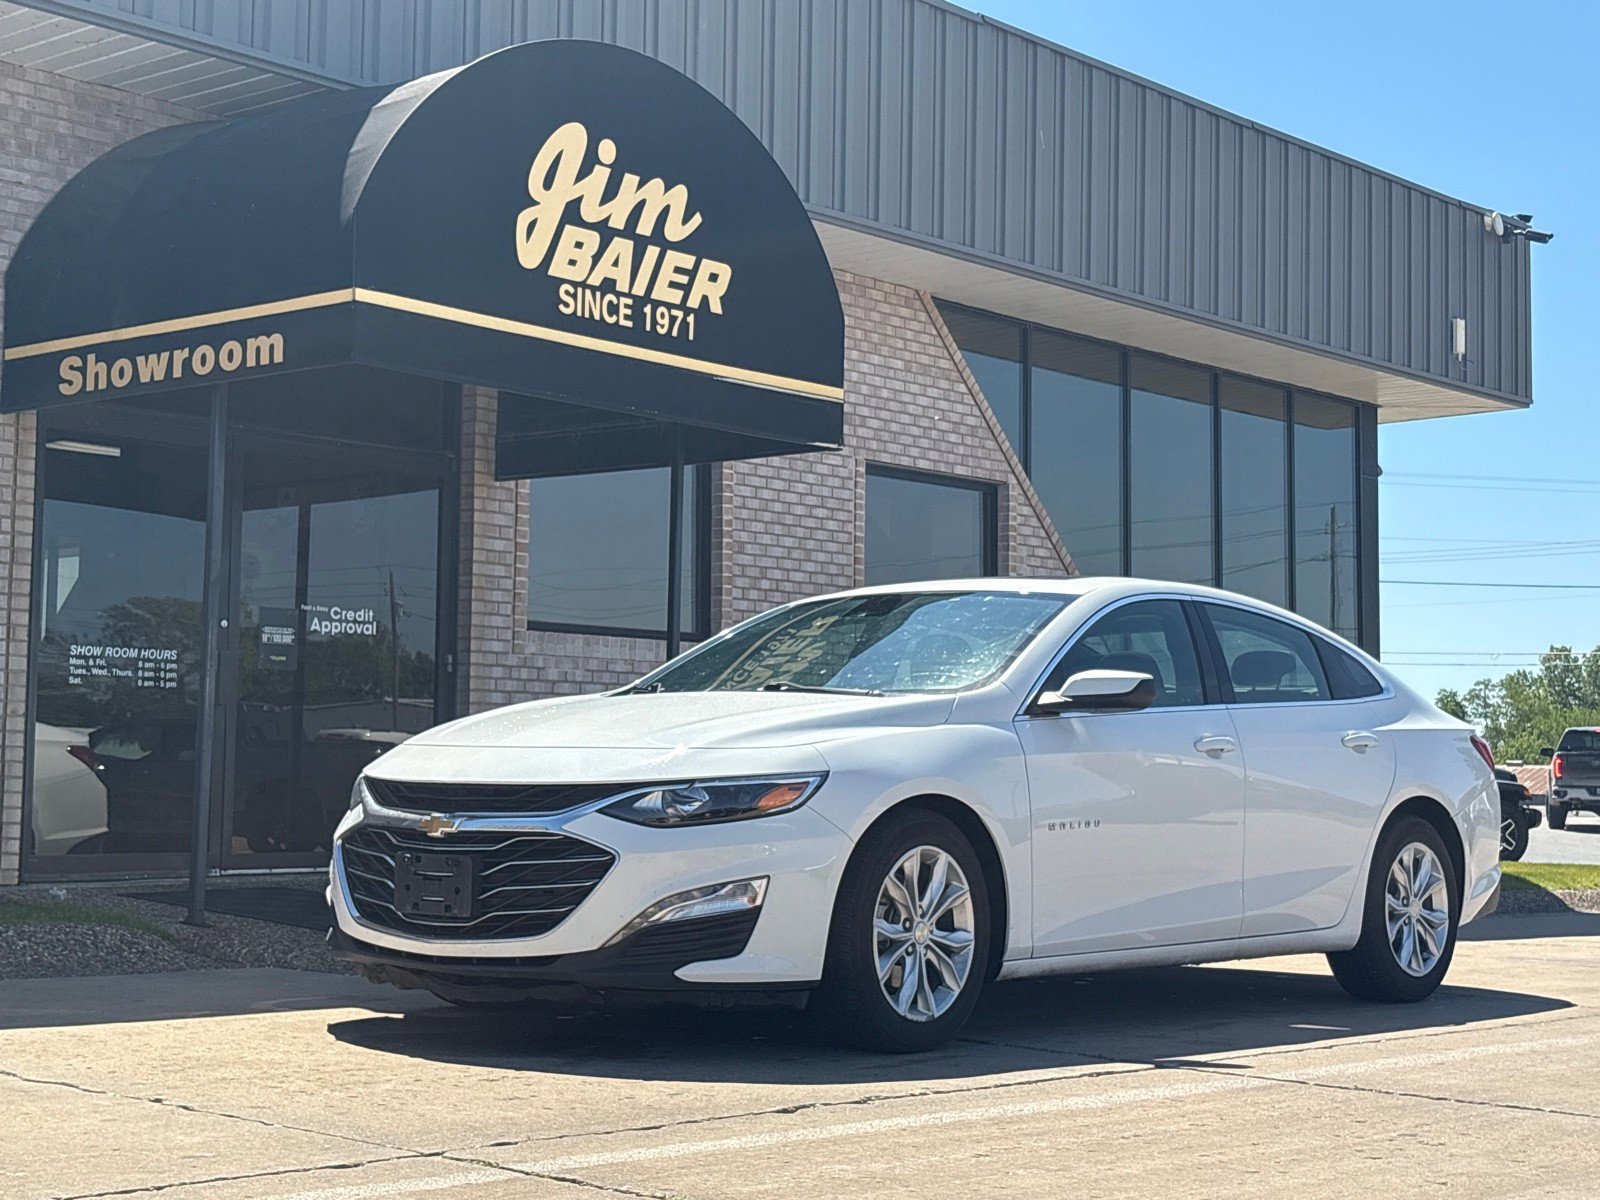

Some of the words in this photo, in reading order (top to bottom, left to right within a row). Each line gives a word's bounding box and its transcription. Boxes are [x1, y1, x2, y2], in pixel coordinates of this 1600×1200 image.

[515, 121, 703, 270] Jim
[547, 224, 733, 315] BAIER
[558, 283, 634, 328] SINCE
[643, 303, 695, 341] 1971
[58, 332, 285, 396] Showroom
[330, 606, 374, 622] Credit
[310, 617, 377, 636] Approval
[70, 645, 103, 656] SHOW
[105, 646, 138, 658] ROOM
[140, 649, 177, 660] HOURS
[69, 656, 87, 666] Mon.
[88, 657, 95, 666] &
[95, 658, 108, 667] Fri.
[138, 660, 143, 668] 8
[160, 661, 165, 669] 6
[166, 663, 178, 671] pm
[111, 668, 135, 677] Thurs.
[138, 669, 143, 677] 8
[160, 670, 165, 678] 6
[166, 672, 178, 680] pm
[68, 676, 83, 685] Sat.
[137, 679, 143, 687] 8
[160, 680, 165, 688] 5
[165, 681, 177, 689] pm
[1047, 819, 1101, 832] MALIBU
